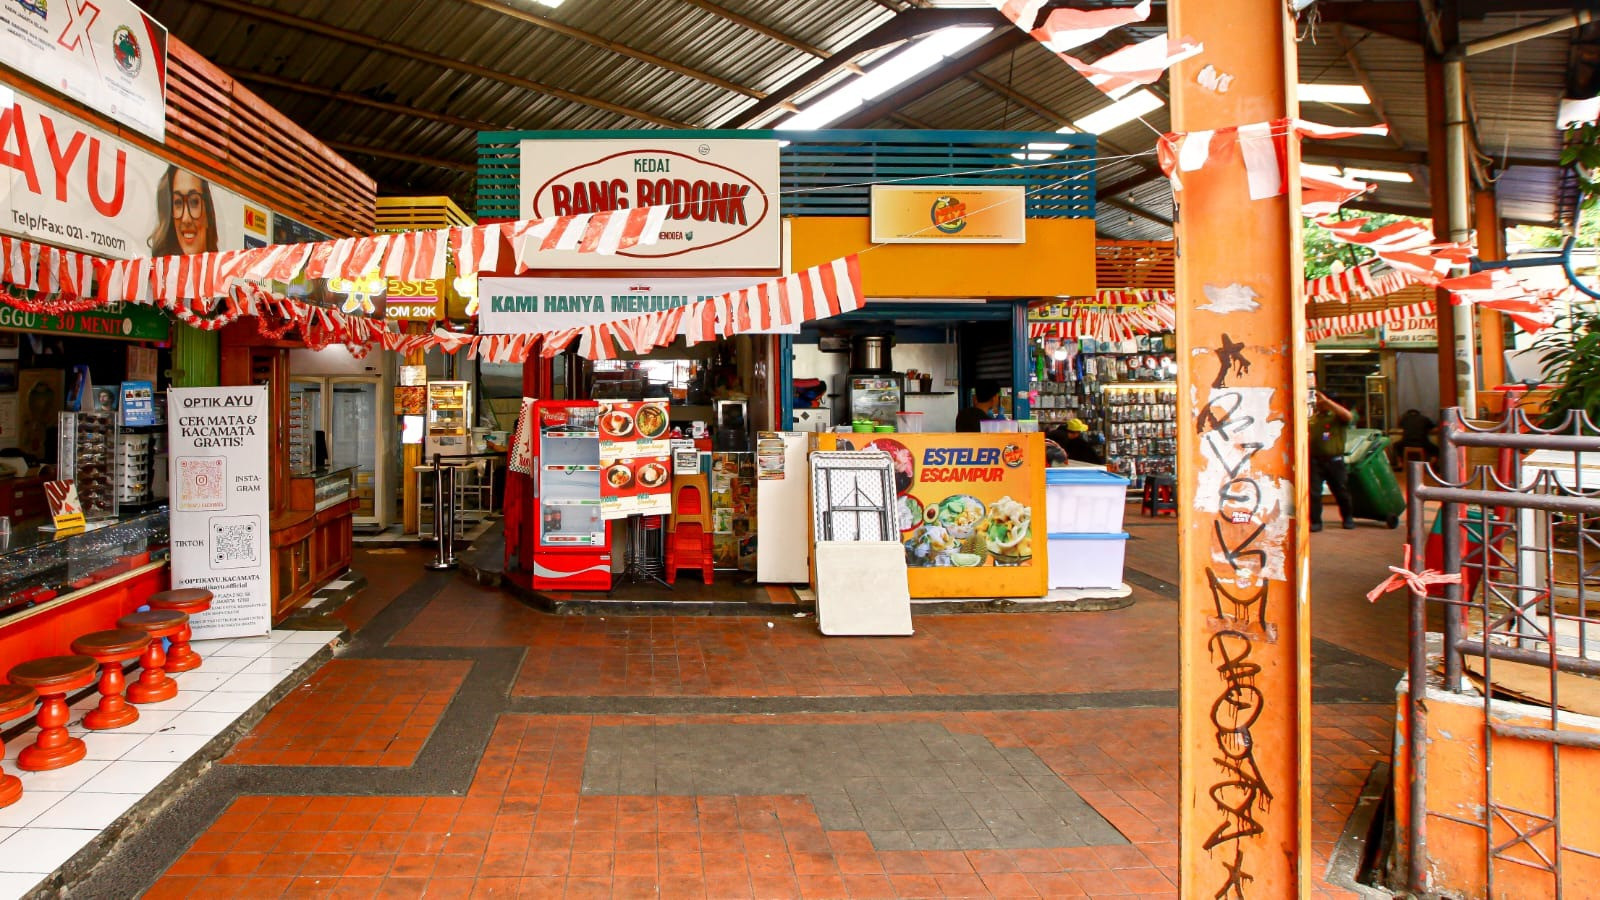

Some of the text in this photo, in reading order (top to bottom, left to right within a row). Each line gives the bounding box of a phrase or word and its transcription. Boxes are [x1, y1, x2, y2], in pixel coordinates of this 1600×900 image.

[0, 103, 127, 218] AYU
[634, 158, 670, 173] KEDAI
[551, 178, 751, 226] BANG BODONK
[12, 210, 64, 234] Telp/Fax:
[66, 225, 83, 240] 021
[91, 231, 126, 251] 7210071
[412, 306, 436, 317] 20K
[491, 295, 538, 312] KAMI
[543, 295, 605, 312] HANYA
[56, 313, 75, 331] 30
[80, 315, 123, 335] MENIT
[183, 395, 253, 408] OPTIK AYU
[179, 415, 257, 426] CEK MATA &
[182, 426, 255, 437] KACAMATA
[194, 437, 244, 448] GRATIS!
[922, 447, 1001, 465] ESTELER
[920, 467, 1004, 483] ESCAMPUR
